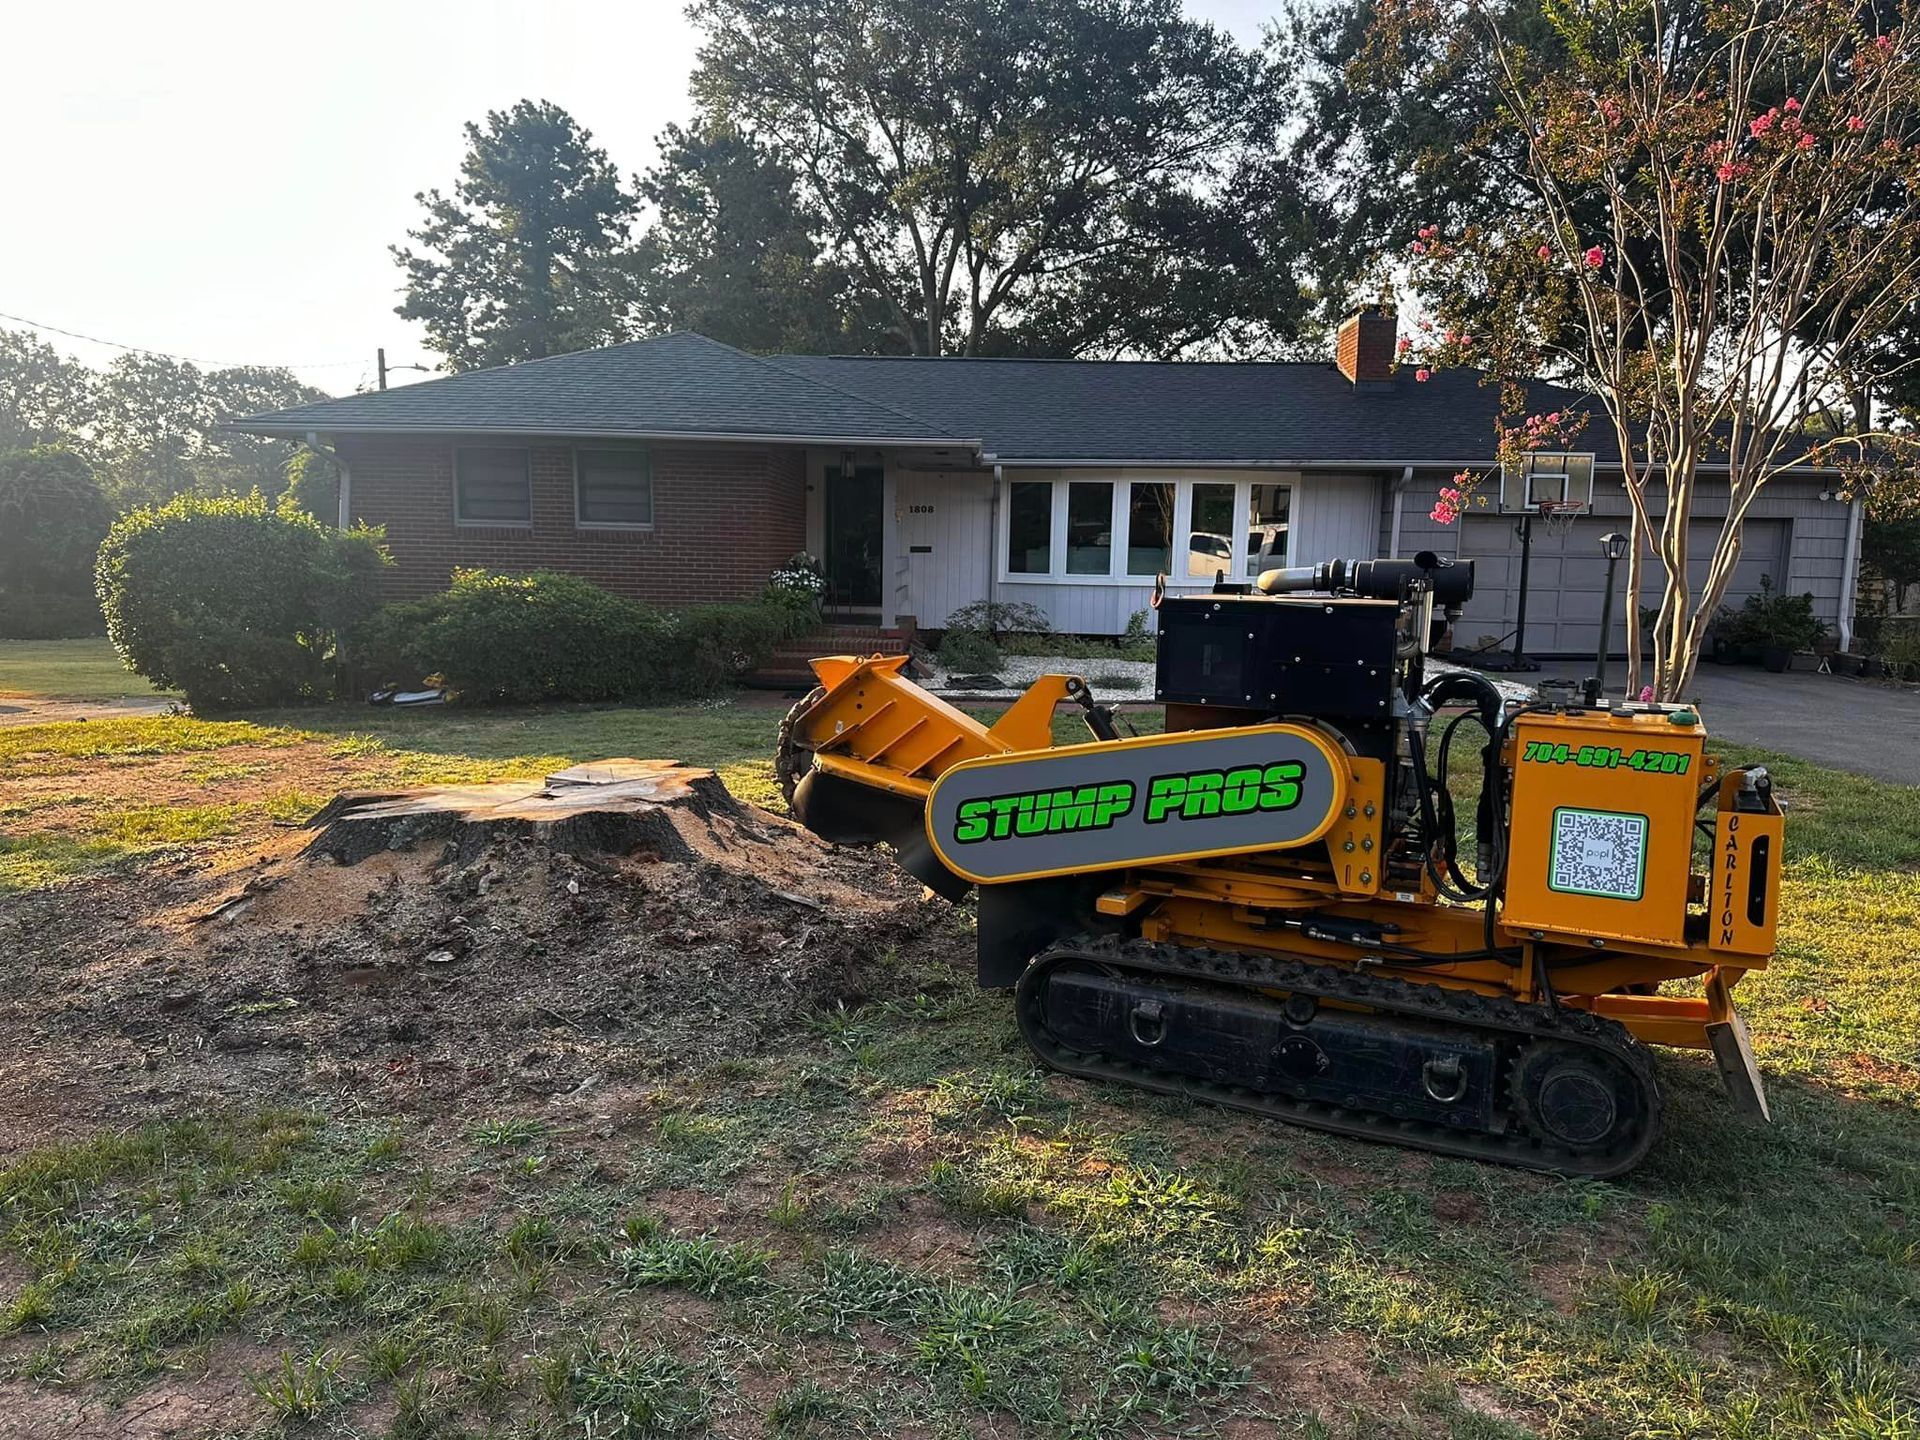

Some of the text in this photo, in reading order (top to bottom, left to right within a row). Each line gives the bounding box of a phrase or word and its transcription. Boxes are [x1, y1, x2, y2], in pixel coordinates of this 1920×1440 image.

[909, 505, 935, 514] 1808
[1523, 741, 1691, 775] 704-691-4201
[955, 760, 1306, 843] STUMP PROS
[1720, 816, 1740, 946] CARLTON
